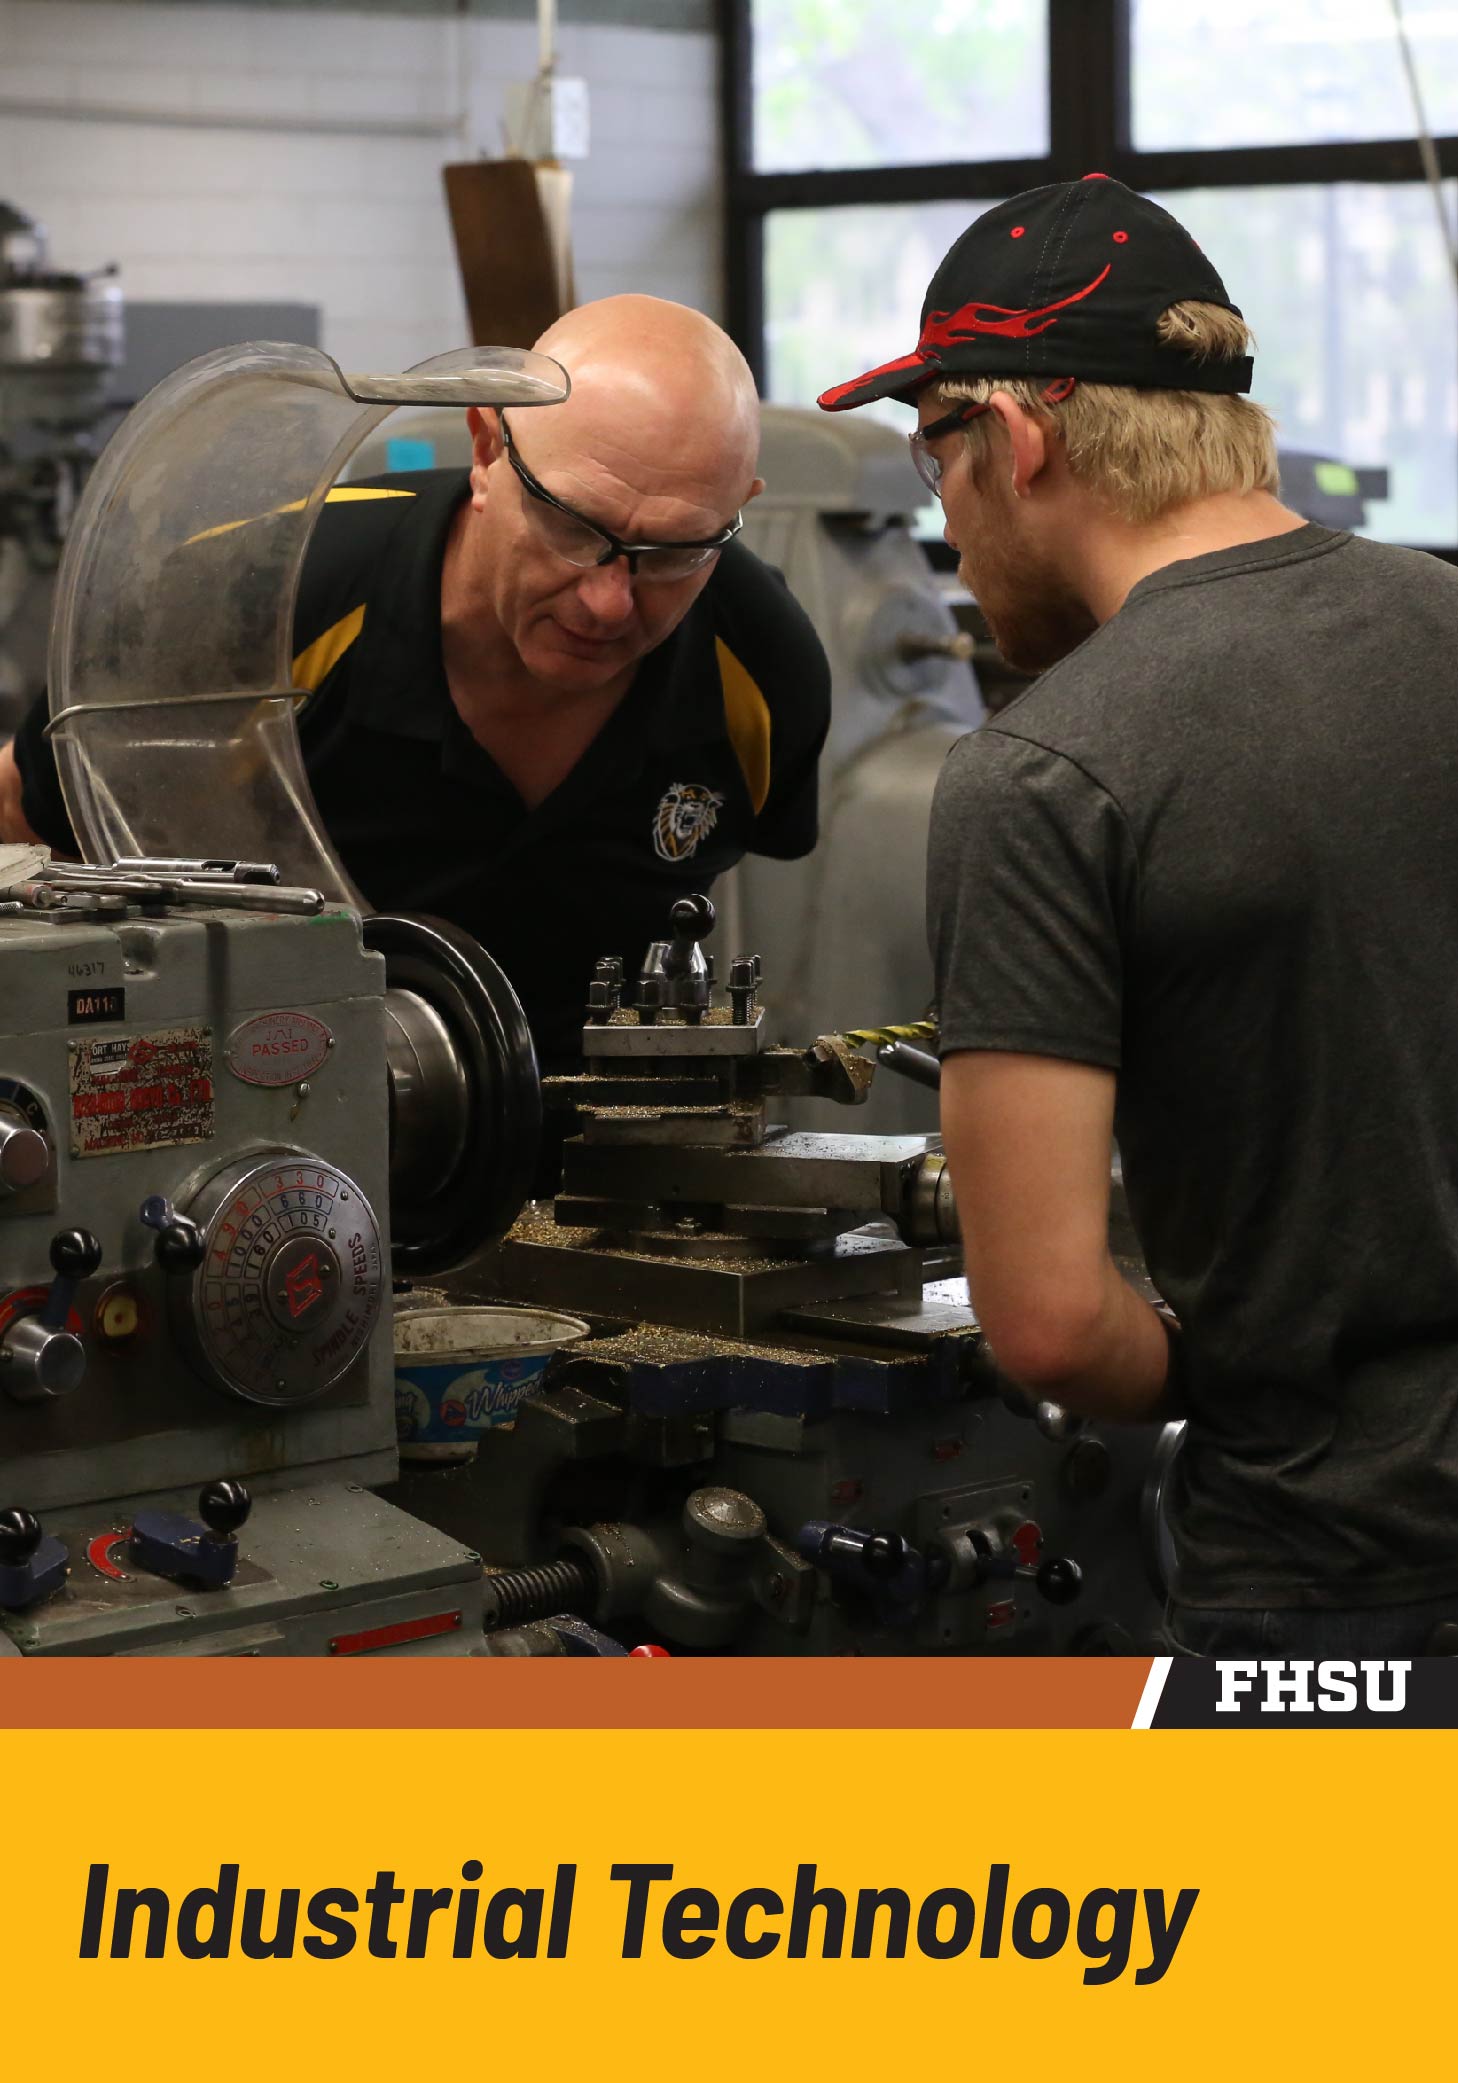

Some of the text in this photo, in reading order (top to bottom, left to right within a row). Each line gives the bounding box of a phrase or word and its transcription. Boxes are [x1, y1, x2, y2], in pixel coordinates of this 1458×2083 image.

[68, 960, 105, 978] 46317
[252, 1038, 309, 1057] PASSED
[274, 1170, 325, 1189] 330
[287, 1211, 320, 1227] 105
[348, 1232, 367, 1296] SPEEDS
[465, 1374, 546, 1422] Whipped
